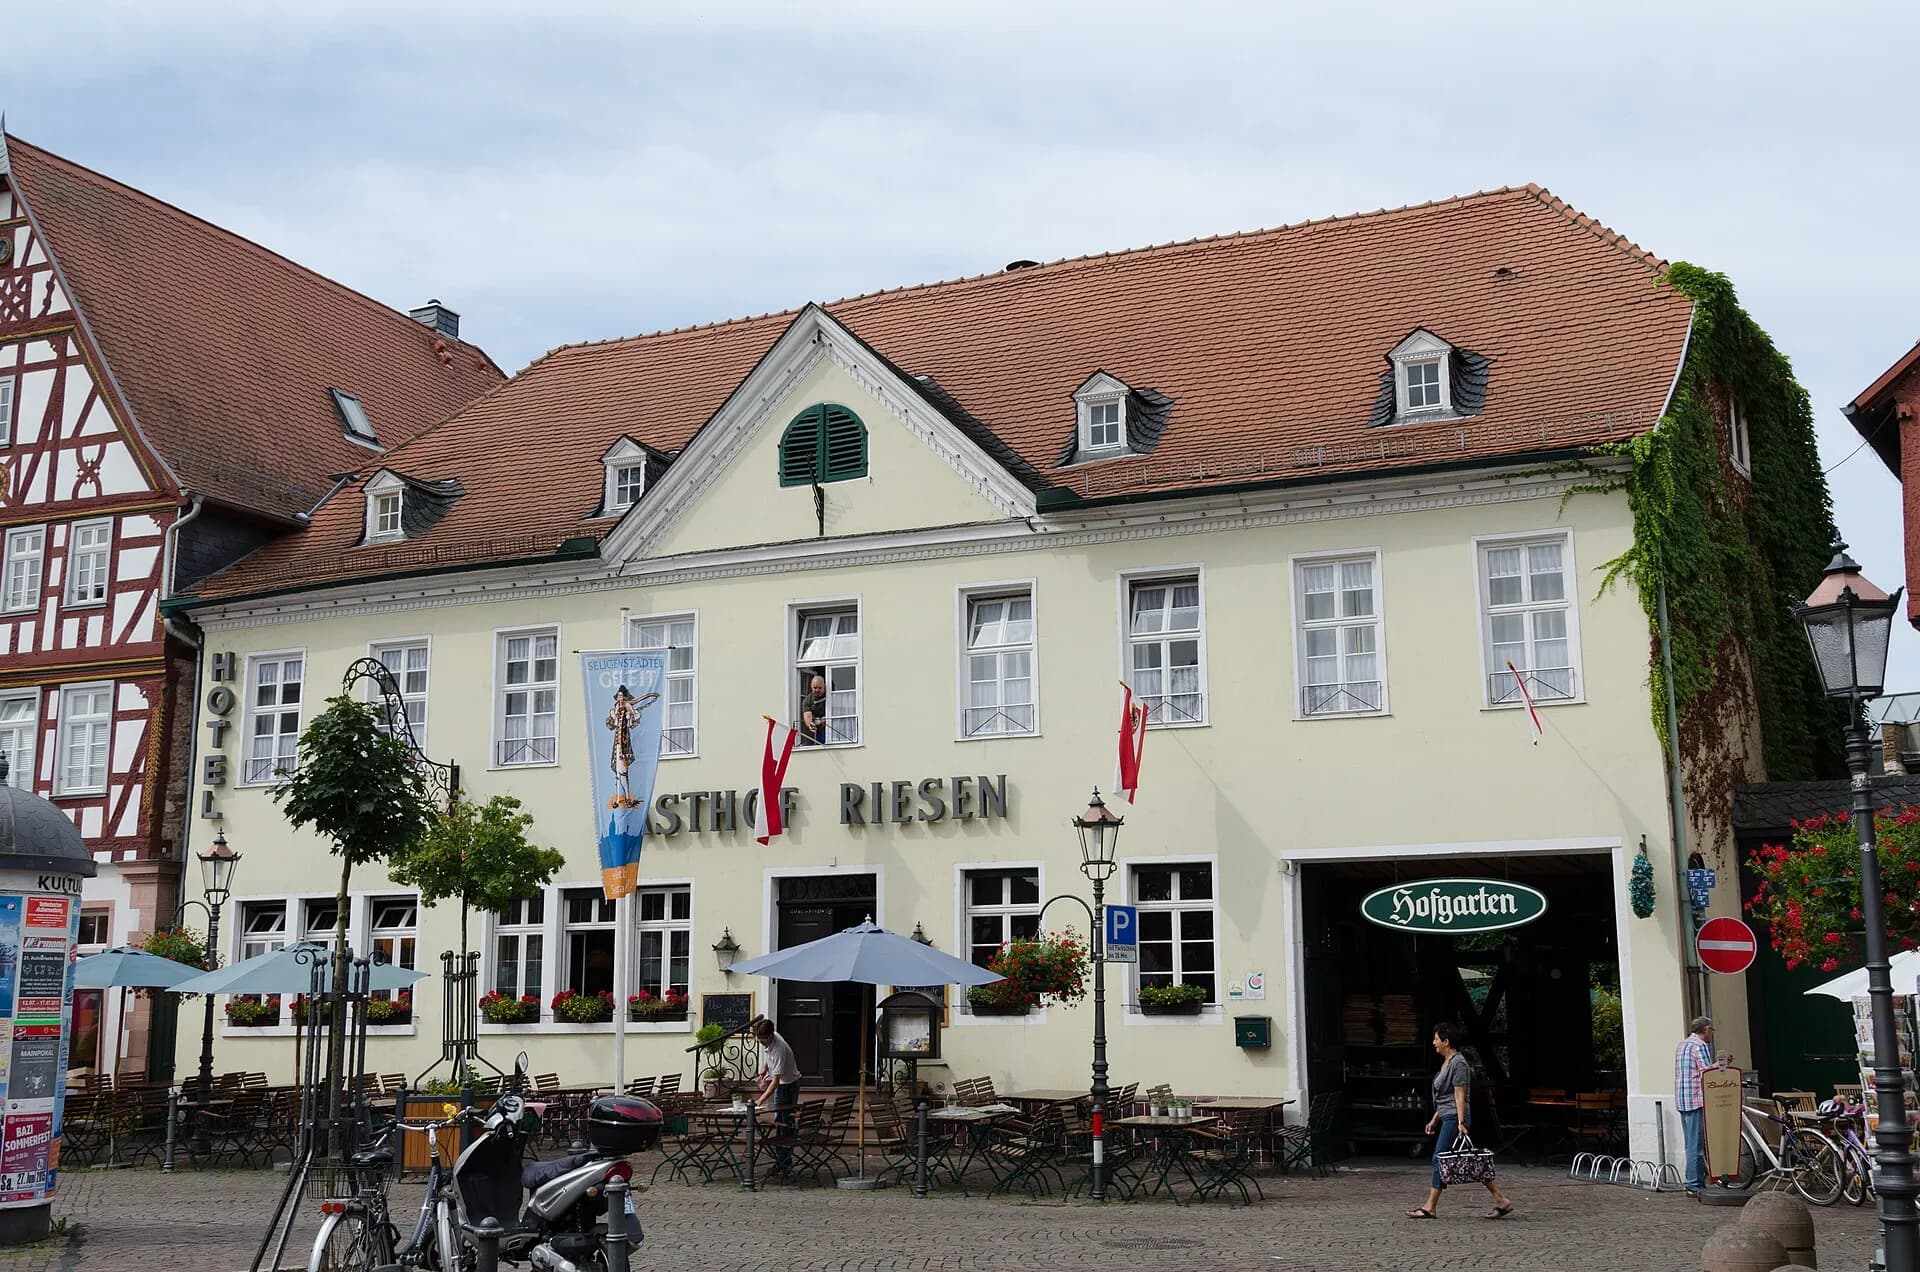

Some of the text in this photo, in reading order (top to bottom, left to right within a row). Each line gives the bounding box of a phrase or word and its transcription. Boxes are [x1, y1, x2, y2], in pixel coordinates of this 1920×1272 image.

[598, 669, 657, 688] GELEIT
[202, 651, 235, 819] HOTEL
[840, 774, 1008, 825] RIESEN
[38, 875, 83, 893] KULTU
[1389, 886, 1518, 925] Hofgarten
[1113, 910, 1130, 940] P
[4, 1131, 51, 1152] SOMMERFEST
[16, 1124, 33, 1138] BAZI
[0, 1174, 14, 1191] Sa.
